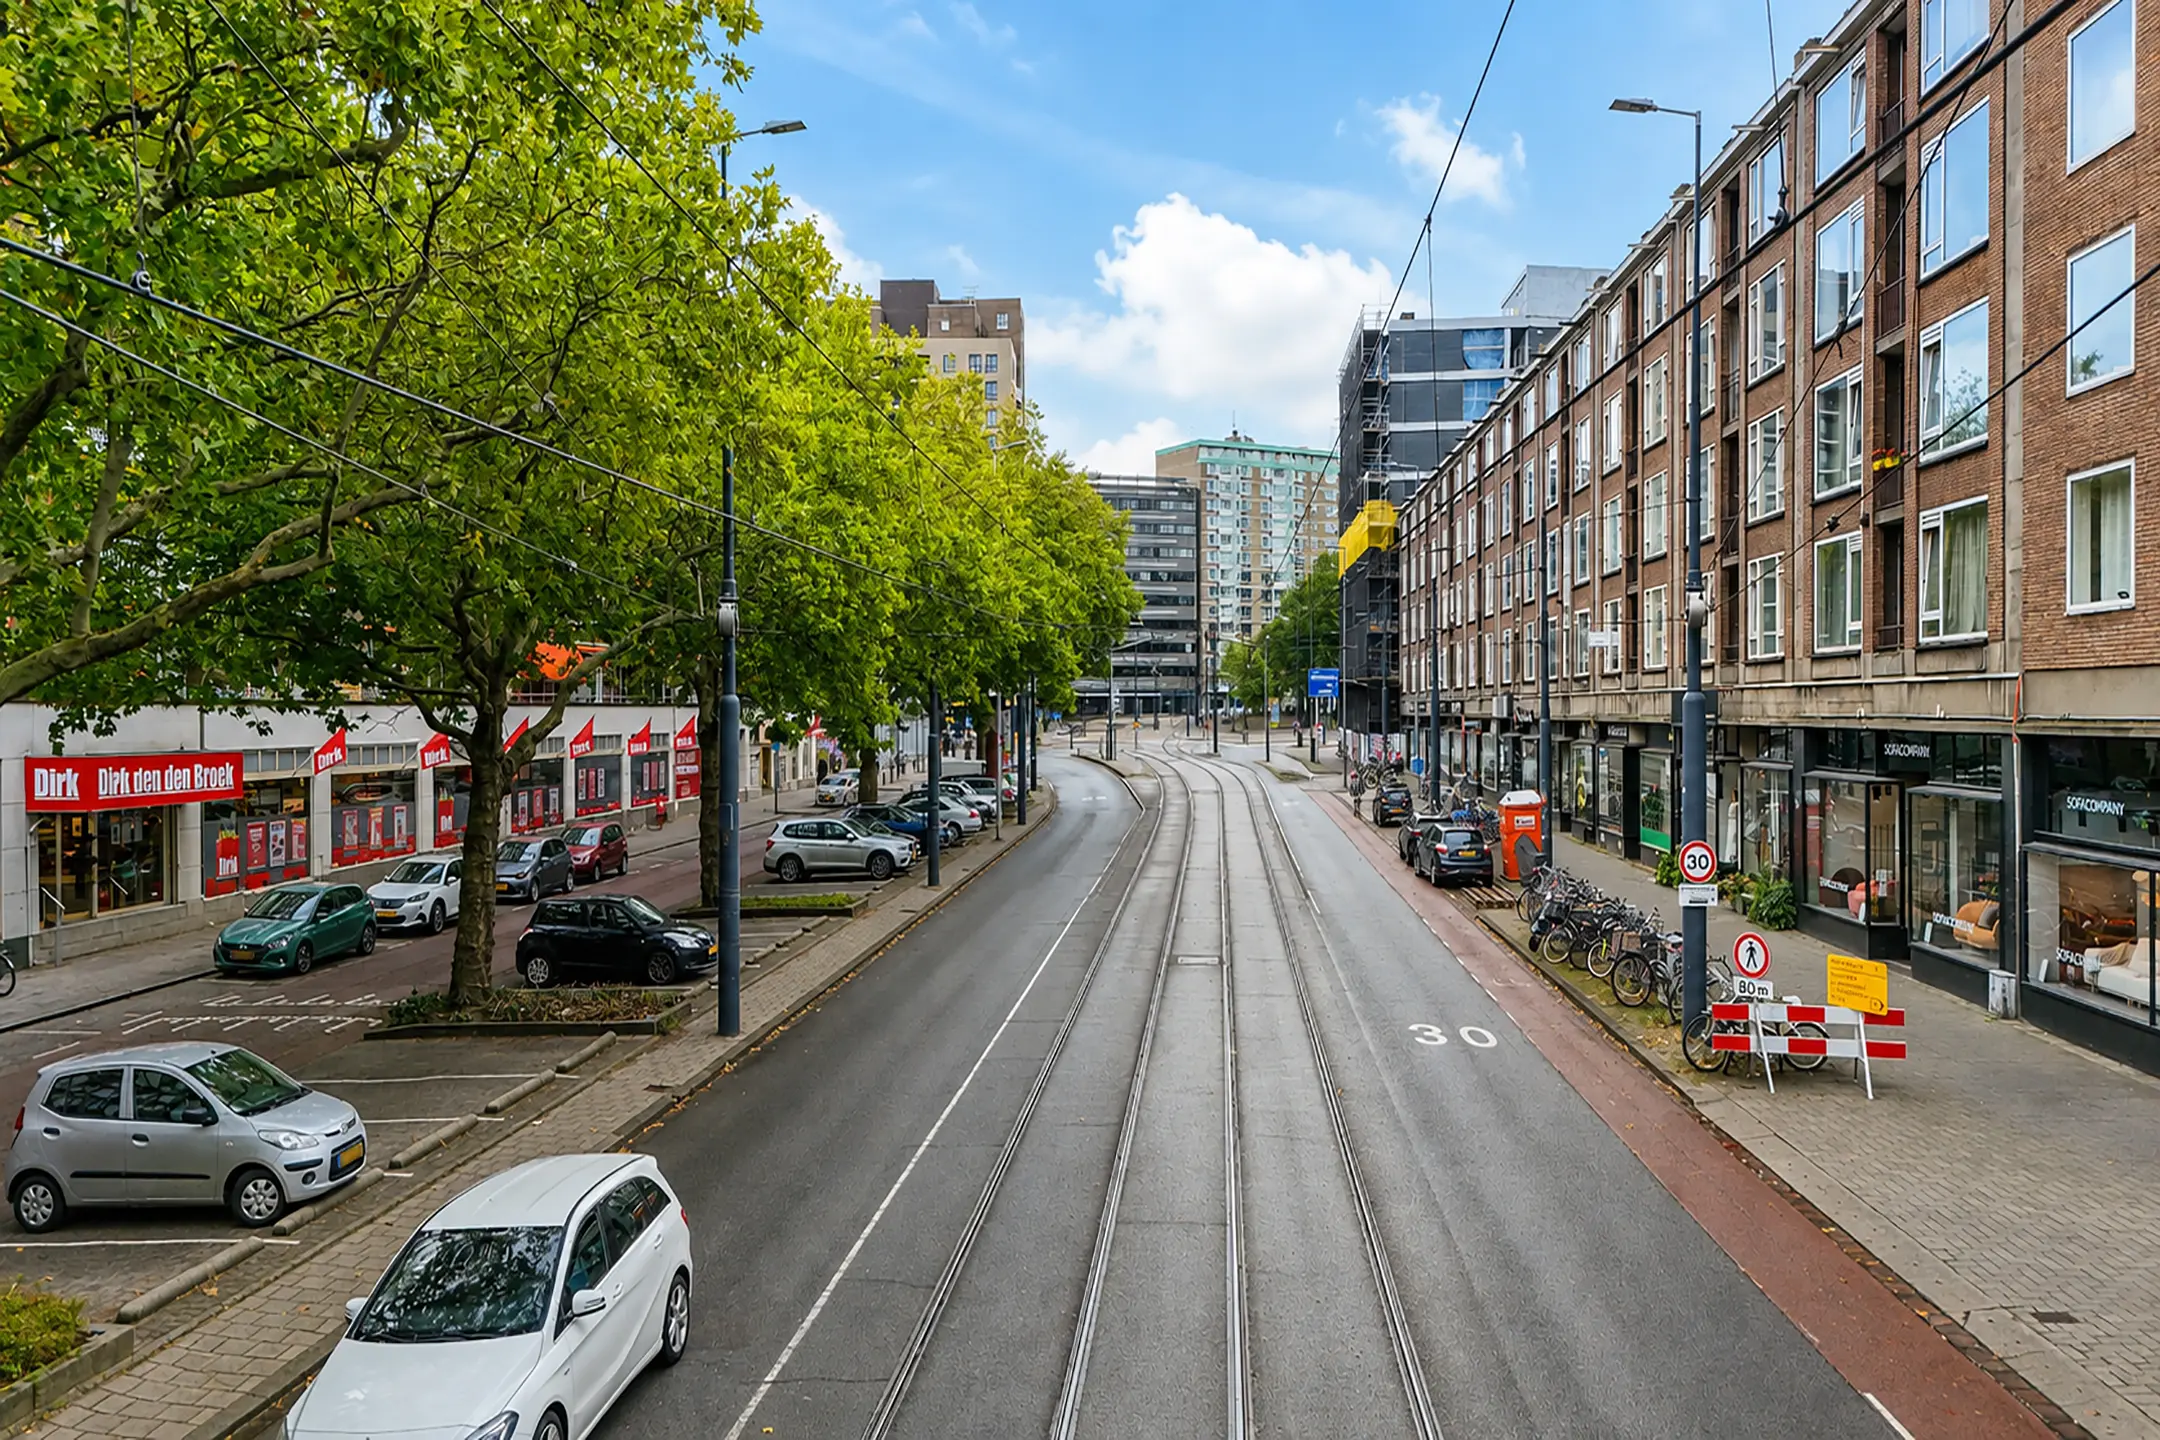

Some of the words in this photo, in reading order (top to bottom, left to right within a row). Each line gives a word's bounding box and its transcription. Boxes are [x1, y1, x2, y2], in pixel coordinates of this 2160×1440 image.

[34, 767, 80, 798] Dirk
[98, 766, 130, 797] Dirk
[133, 767, 161, 793] den
[164, 764, 190, 791] den
[194, 762, 234, 789] Broek
[2066, 795, 2125, 817] SOFACOMPANY
[1687, 854, 1709, 870] 30
[1738, 980, 1756, 994] 80
[1757, 985, 1769, 996] m
[1408, 1023, 1498, 1048] 30
